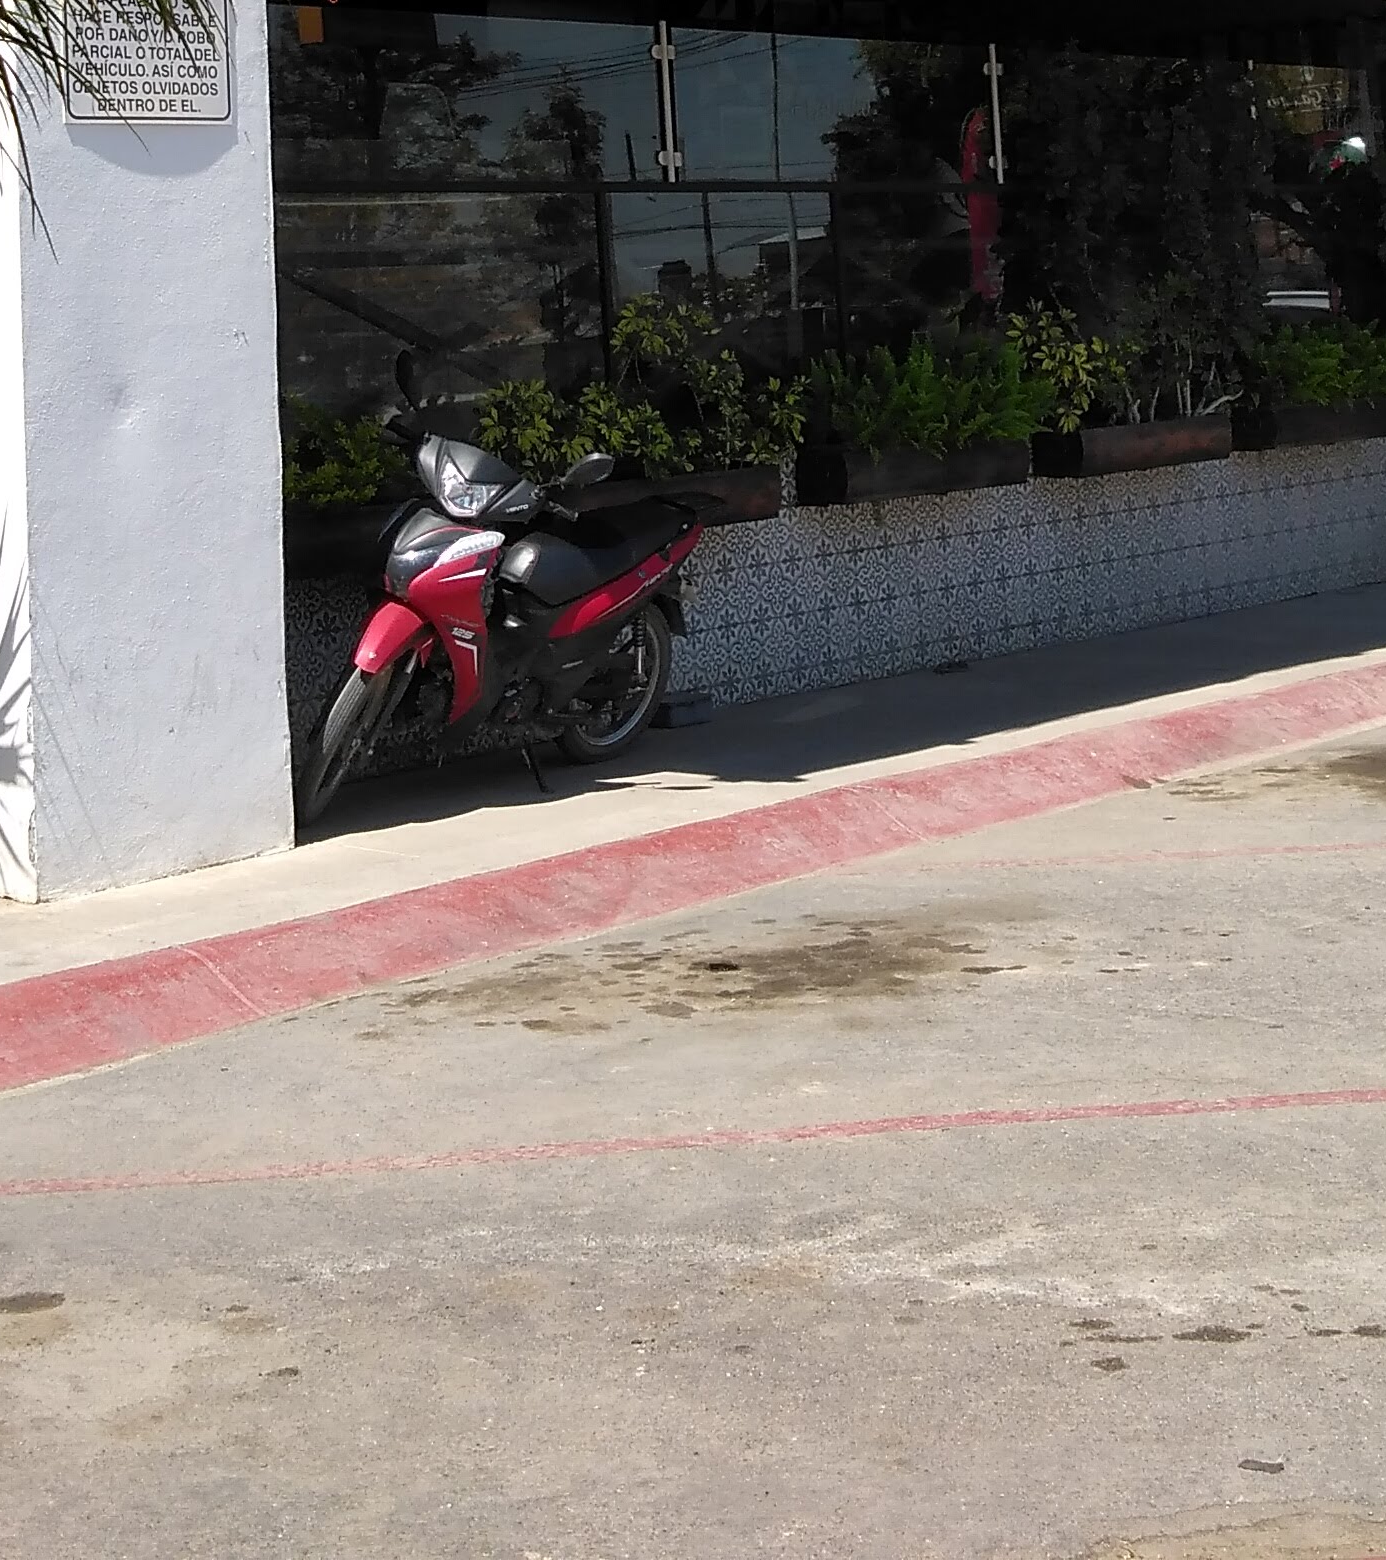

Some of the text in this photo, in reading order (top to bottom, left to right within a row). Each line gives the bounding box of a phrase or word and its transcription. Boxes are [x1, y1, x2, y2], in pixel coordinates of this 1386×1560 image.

[73, 9, 216, 27] HACE RESPOSABE
[75, 26, 105, 41] POR
[178, 30, 216, 44] ROBO
[72, 44, 220, 62] PARCIAL O TOTAL DEL
[152, 61, 174, 78] ASÍ
[177, 65, 218, 78] COMO
[72, 80, 219, 96] OBJETOS OLVIDADOS
[98, 98, 201, 113] DENTRO DE EL.
[452, 626, 476, 640] 125
